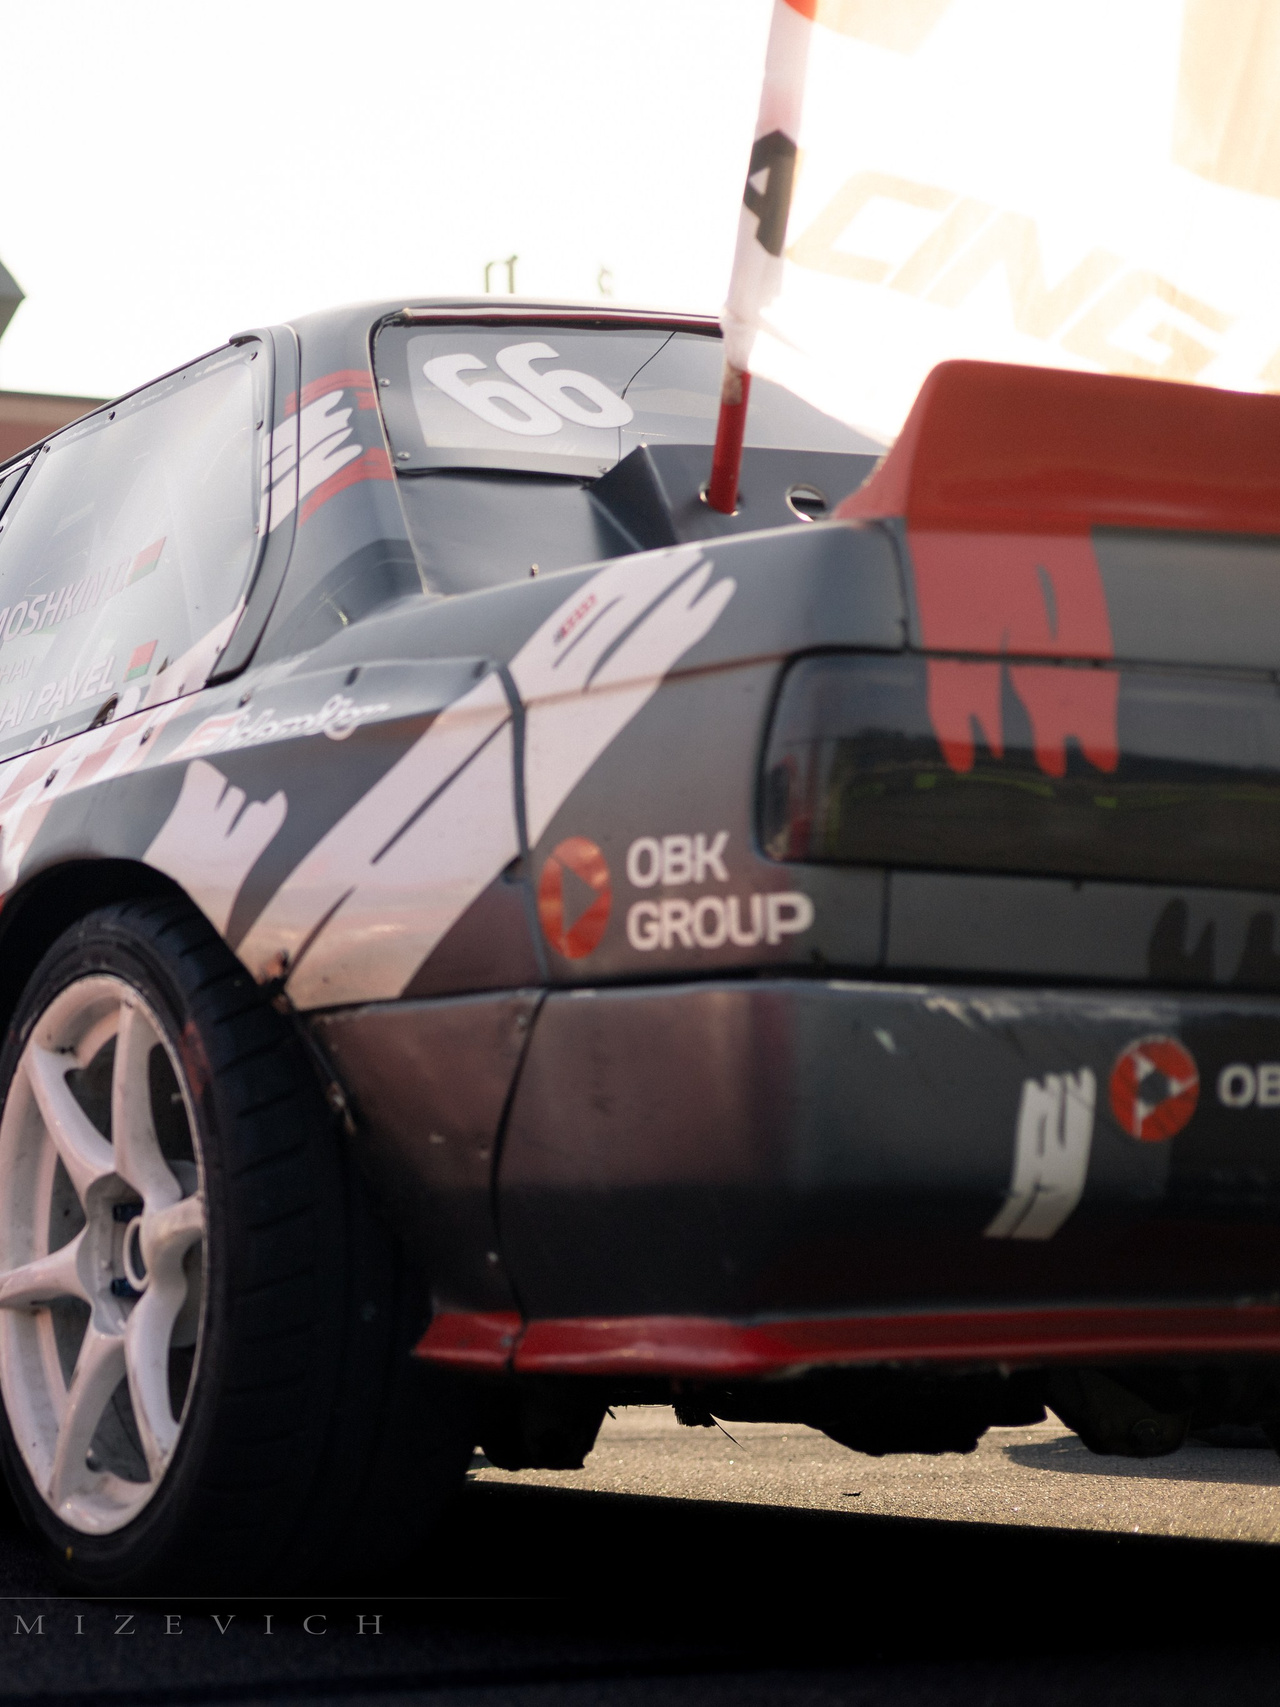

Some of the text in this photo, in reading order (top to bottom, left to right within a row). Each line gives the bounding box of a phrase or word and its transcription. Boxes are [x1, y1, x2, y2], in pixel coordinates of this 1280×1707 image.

[422, 341, 634, 436] 66
[30, 655, 116, 721] PAVEL
[626, 830, 730, 888] OBK
[625, 891, 815, 951] GROUP
